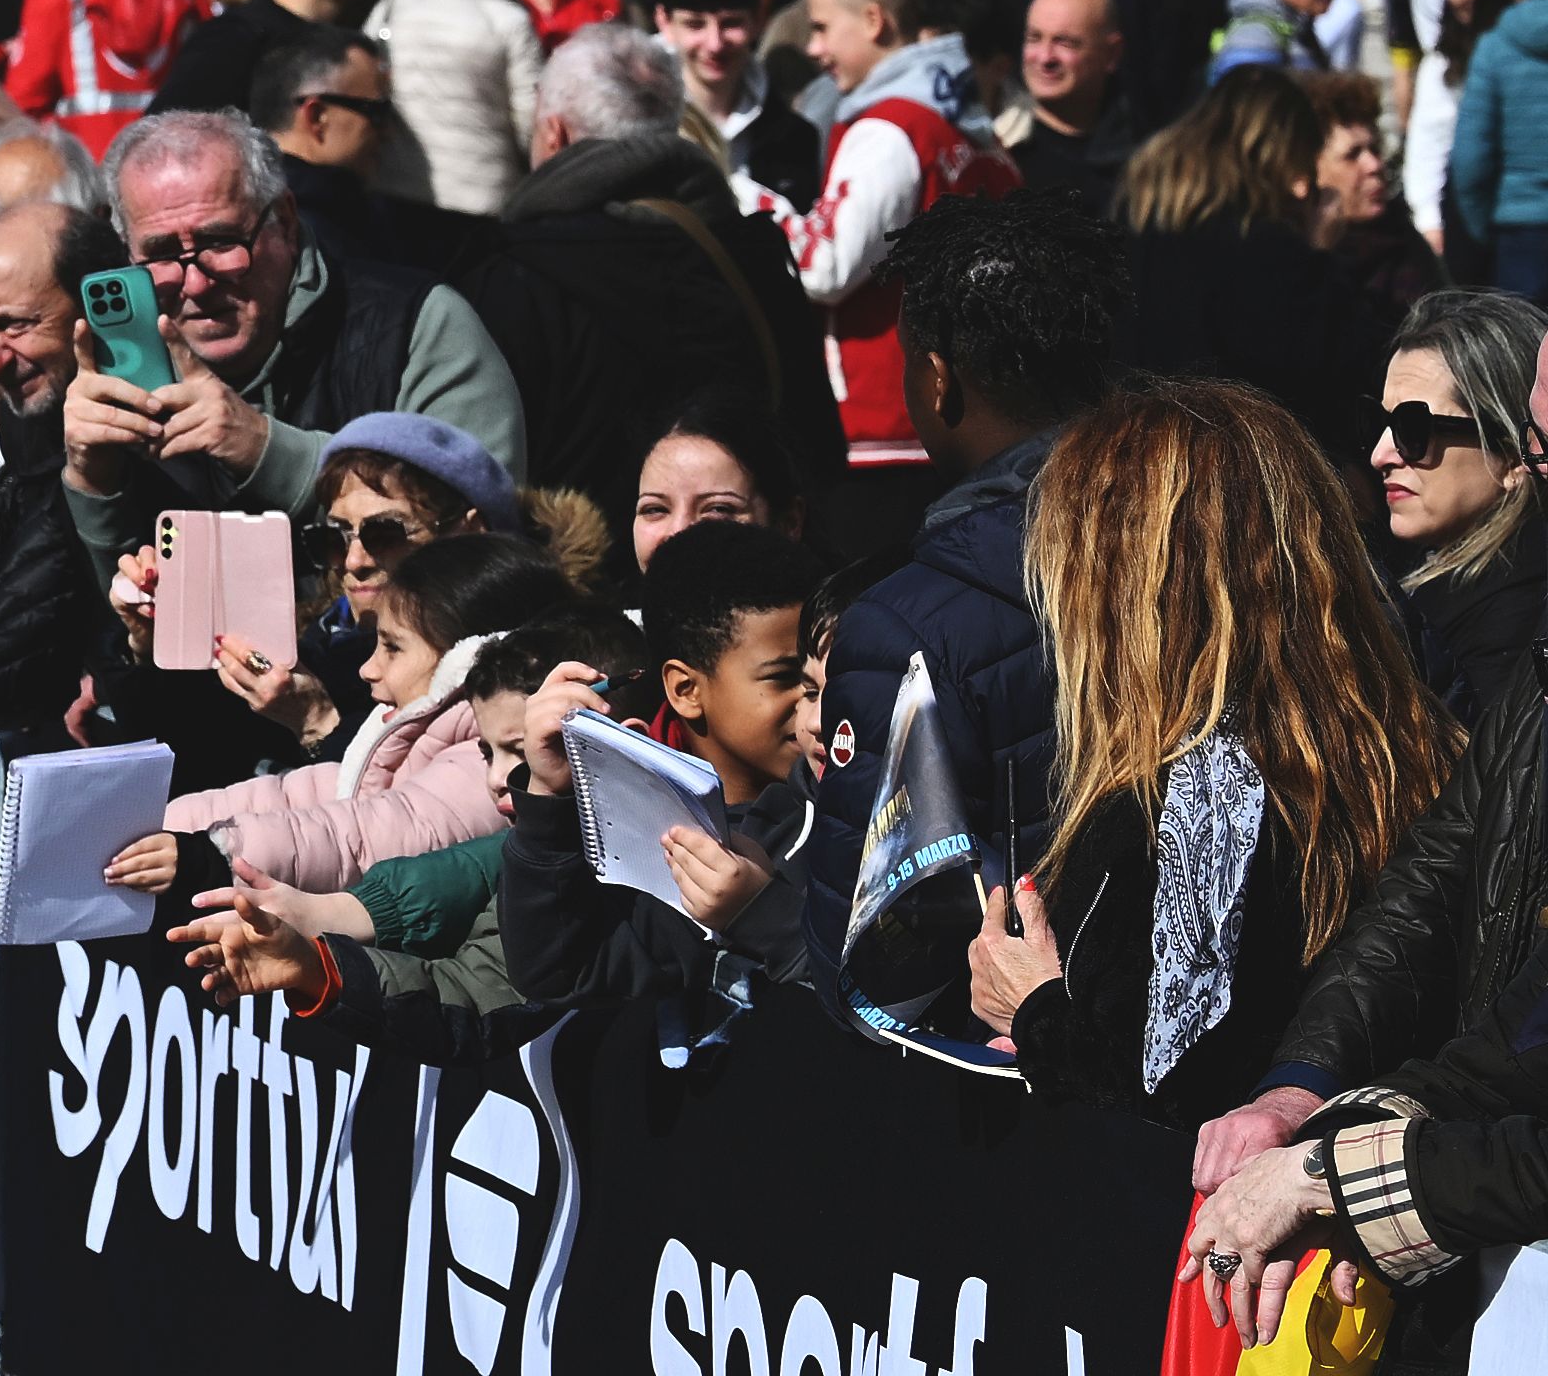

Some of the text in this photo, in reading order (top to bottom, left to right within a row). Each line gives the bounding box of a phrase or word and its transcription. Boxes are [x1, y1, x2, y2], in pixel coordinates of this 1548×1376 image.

[886, 833, 971, 890] 9-15 MARZO
[48, 940, 371, 1313] sportful
